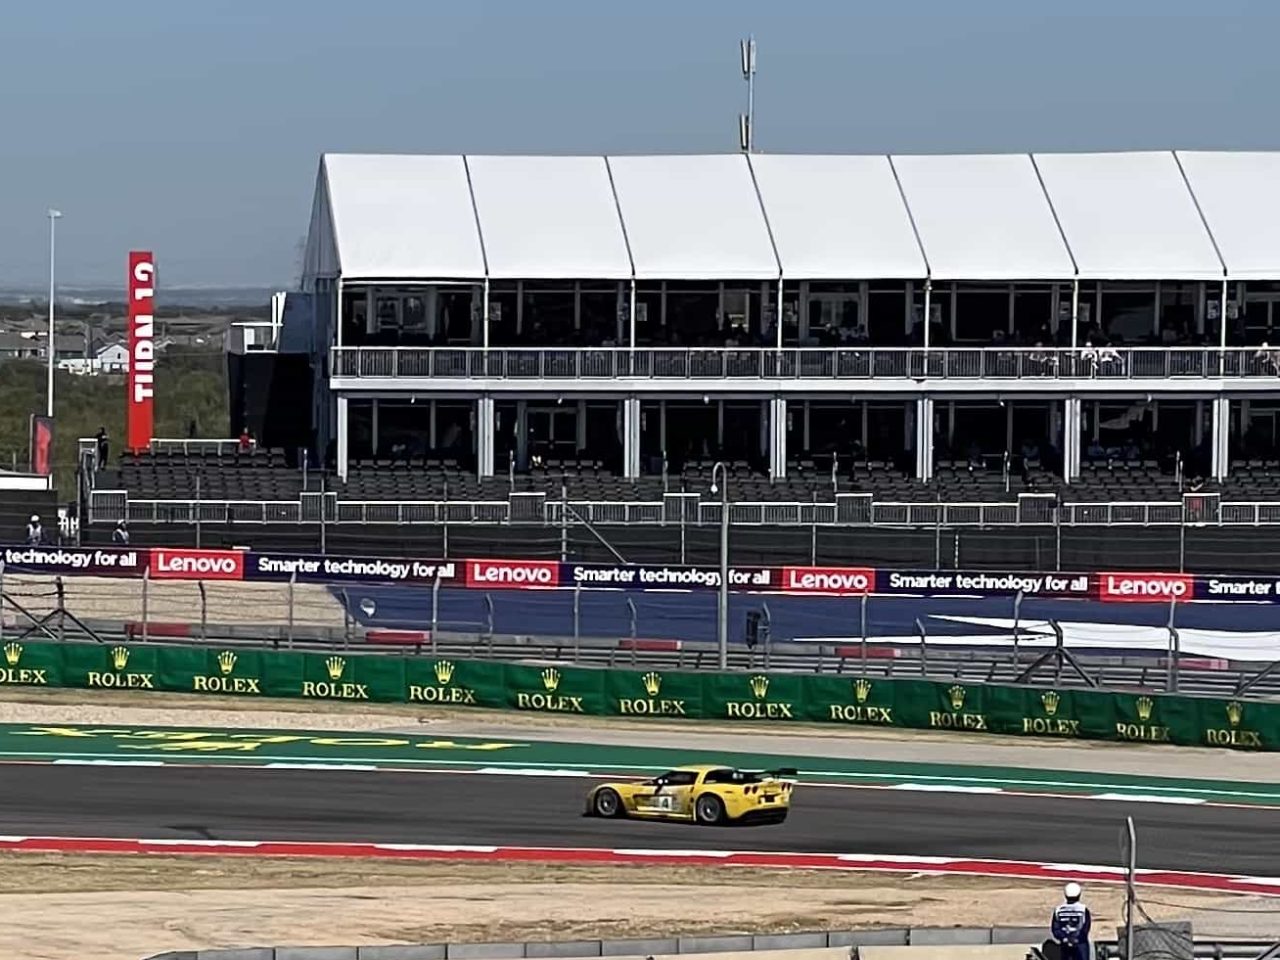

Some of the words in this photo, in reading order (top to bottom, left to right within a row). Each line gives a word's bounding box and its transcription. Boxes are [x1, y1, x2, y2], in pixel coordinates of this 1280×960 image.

[6, 547, 92, 567] technology
[95, 548, 116, 565] for
[115, 553, 136, 566] all
[155, 549, 238, 572] Lenovo
[259, 558, 320, 576] Smarter
[324, 556, 410, 578] technology
[413, 559, 435, 576] for
[434, 559, 454, 580] all
[471, 559, 553, 582] Lenovo
[574, 563, 635, 586] Smarter
[638, 564, 721, 585] technology
[729, 566, 750, 583] for
[748, 566, 772, 584] all
[788, 567, 870, 592] Lenovo
[890, 570, 952, 587] Smarter
[954, 571, 1042, 597] technology
[1046, 576, 1068, 590] for
[1067, 573, 1087, 590] all
[1105, 573, 1188, 600] Lenovo
[1209, 576, 1273, 594] Smarter
[88, 671, 154, 688] ROLEX
[194, 676, 260, 692] ROLEX
[302, 682, 369, 698] ROLEX
[410, 685, 476, 703] ROLEX
[518, 693, 584, 711] ROLEX
[620, 699, 685, 715] ROLEX
[727, 702, 792, 718] ROLEX
[830, 705, 892, 722] ROLEX
[930, 712, 987, 730] ROLEX
[1023, 718, 1079, 735] ROLEX
[1116, 723, 1170, 742] ROLEX
[1207, 729, 1262, 747] ROLEX
